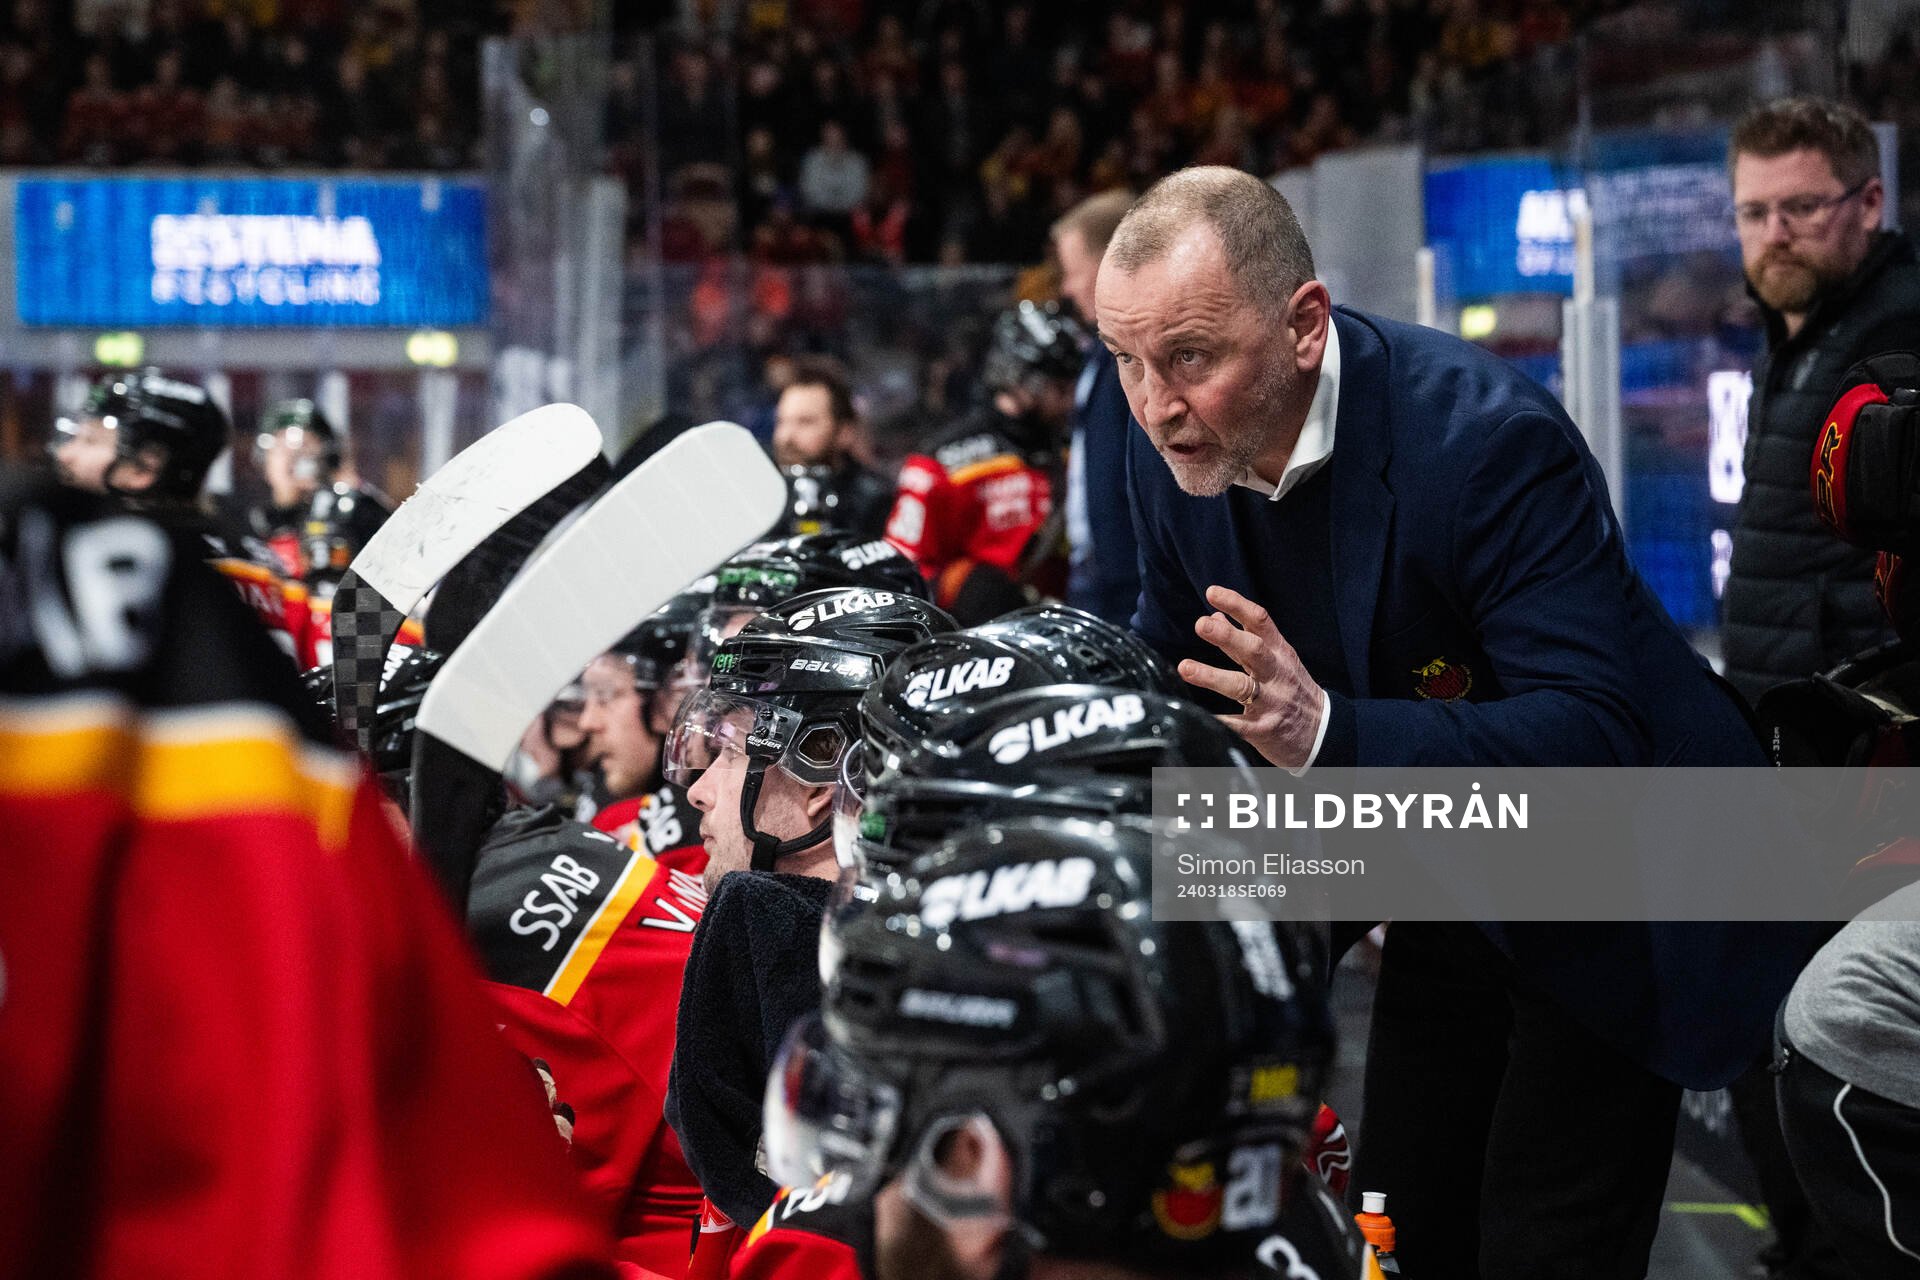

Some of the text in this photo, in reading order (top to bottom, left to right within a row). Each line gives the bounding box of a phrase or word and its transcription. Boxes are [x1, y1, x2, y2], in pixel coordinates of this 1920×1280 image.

[817, 592, 896, 622] LKAB
[930, 656, 1015, 701] LKAB
[1031, 694, 1146, 752] LKAB
[510, 854, 600, 952] SSAB
[958, 857, 1097, 922] LKAB
